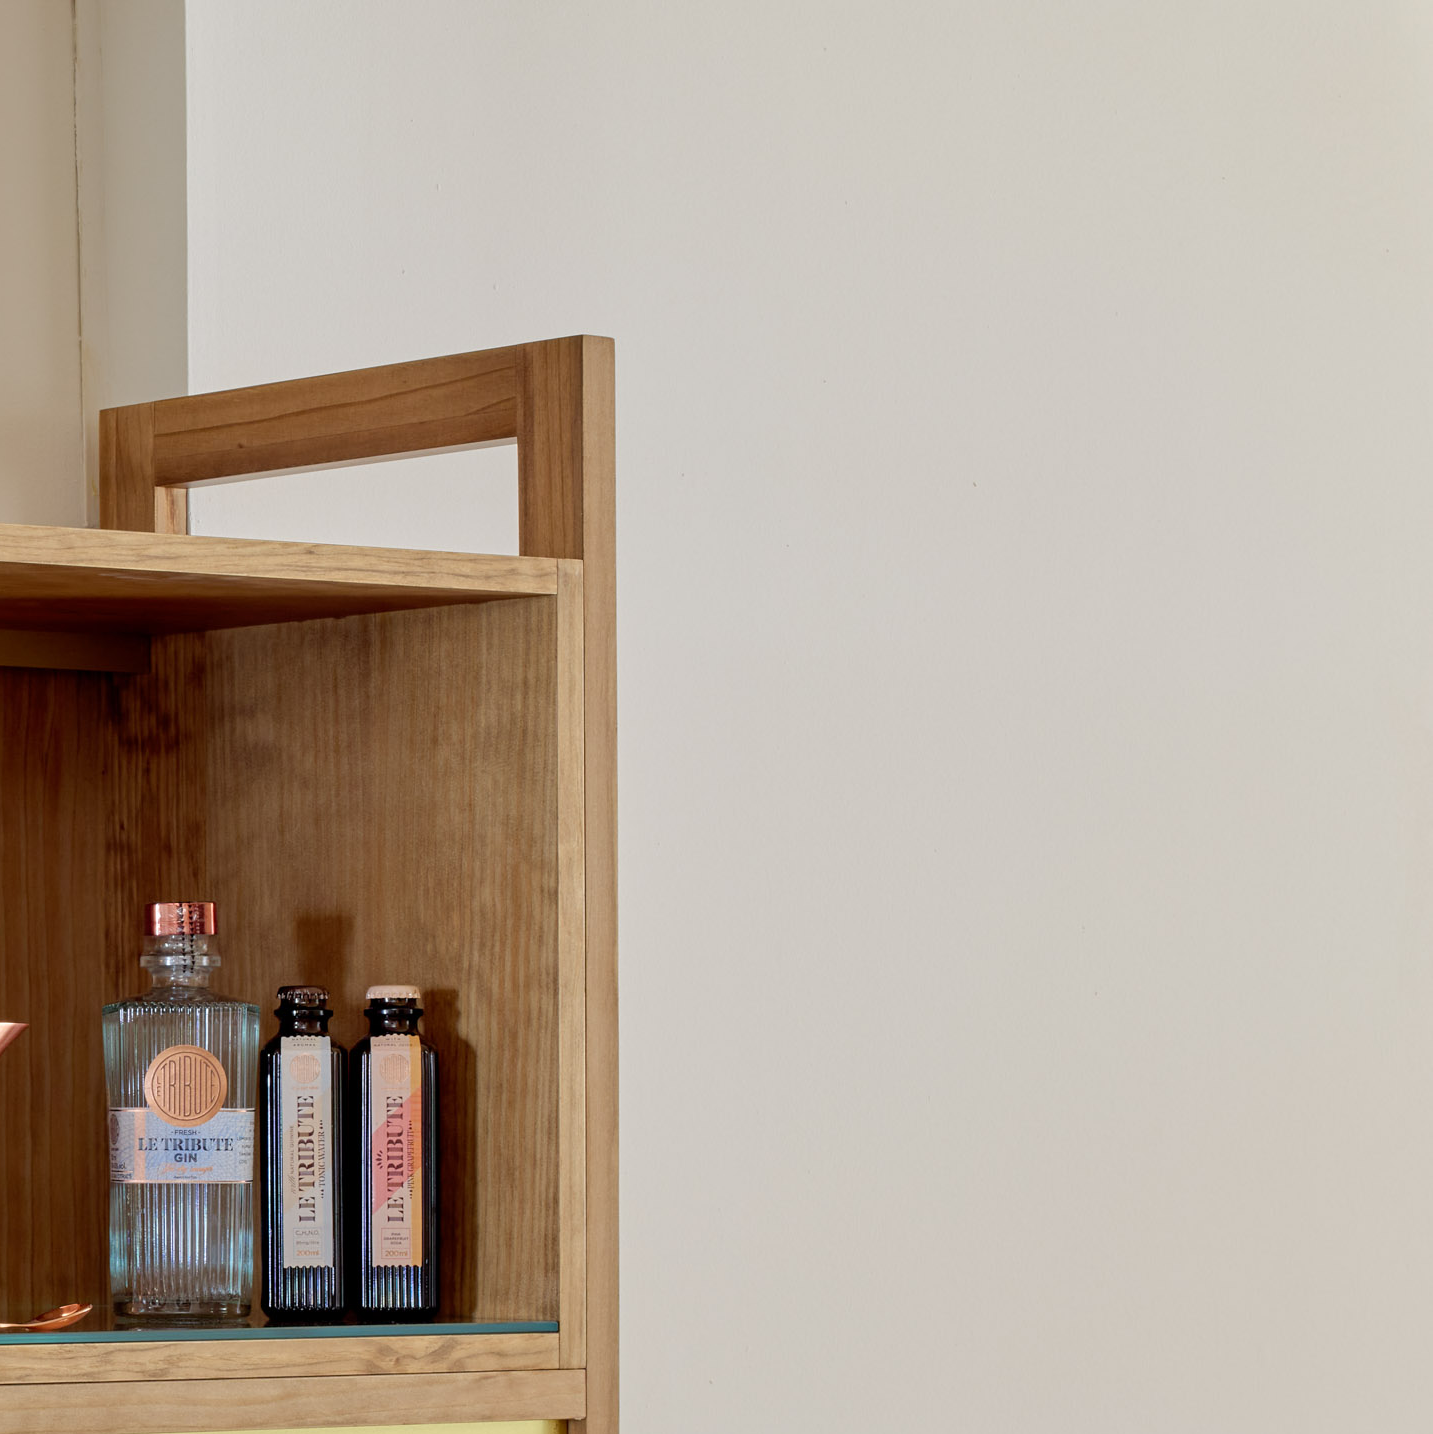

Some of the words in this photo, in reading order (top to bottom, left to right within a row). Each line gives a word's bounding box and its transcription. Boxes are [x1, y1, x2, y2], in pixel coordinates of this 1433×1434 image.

[161, 1056, 216, 1117] TRIBUTE
[138, 1138, 158, 1151] LE
[160, 1138, 234, 1152] TRIBUTE
[297, 1095, 315, 1193] TRIBUTE
[386, 1096, 404, 1193] TRIBUTE
[174, 1153, 198, 1163] GIN
[318, 1161, 326, 1188] TONIC
[298, 1197, 316, 1223] LE
[387, 1197, 404, 1223] LE
